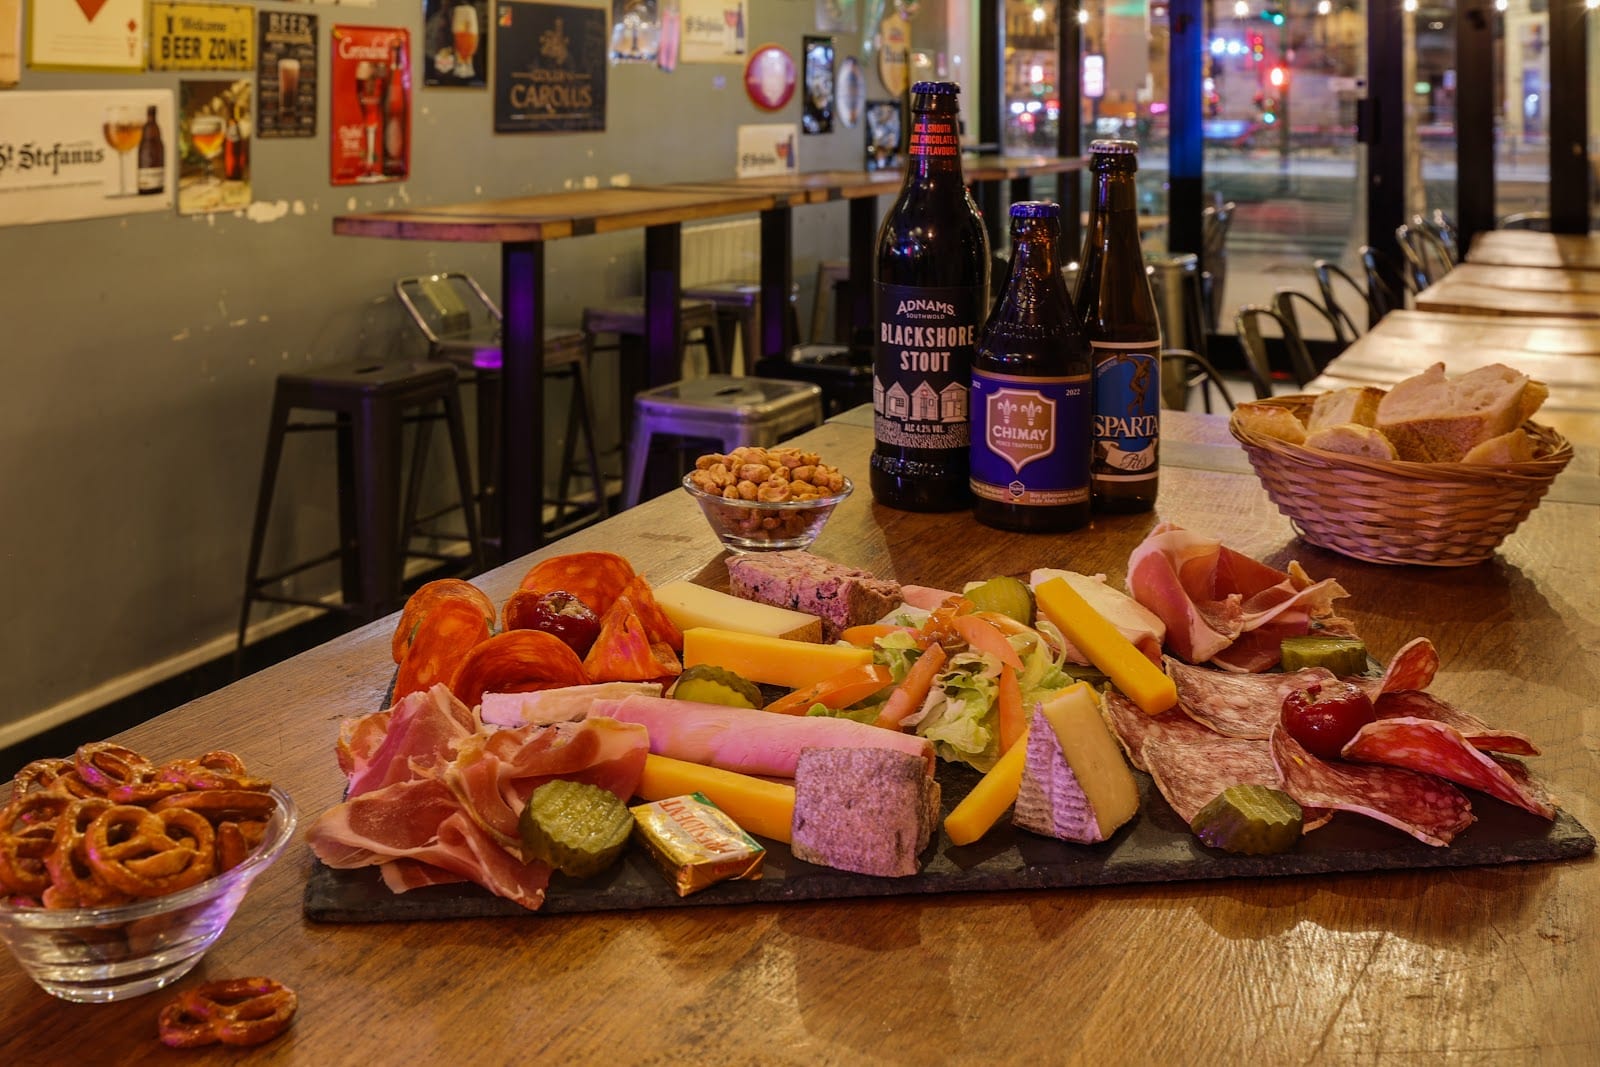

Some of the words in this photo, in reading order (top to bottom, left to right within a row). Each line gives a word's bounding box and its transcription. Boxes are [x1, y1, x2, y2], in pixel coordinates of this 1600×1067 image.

[269, 13, 311, 35] BEER
[161, 35, 202, 60] BEER
[208, 37, 248, 61] ZONE
[927, 123, 951, 133] SMOOTH
[920, 134, 953, 145] CHOCOLATE
[16, 142, 104, 176] Stefanus
[926, 146, 957, 156] FLAVOURS
[896, 299, 954, 316] ADNAMS
[906, 312, 945, 320] SOUTHWOLD
[881, 321, 975, 348] BLACKSHORE
[900, 350, 951, 373] STOUT
[1065, 388, 1080, 397] 2022
[904, 423, 916, 433] ALC
[992, 425, 1049, 441] CHIMAY
